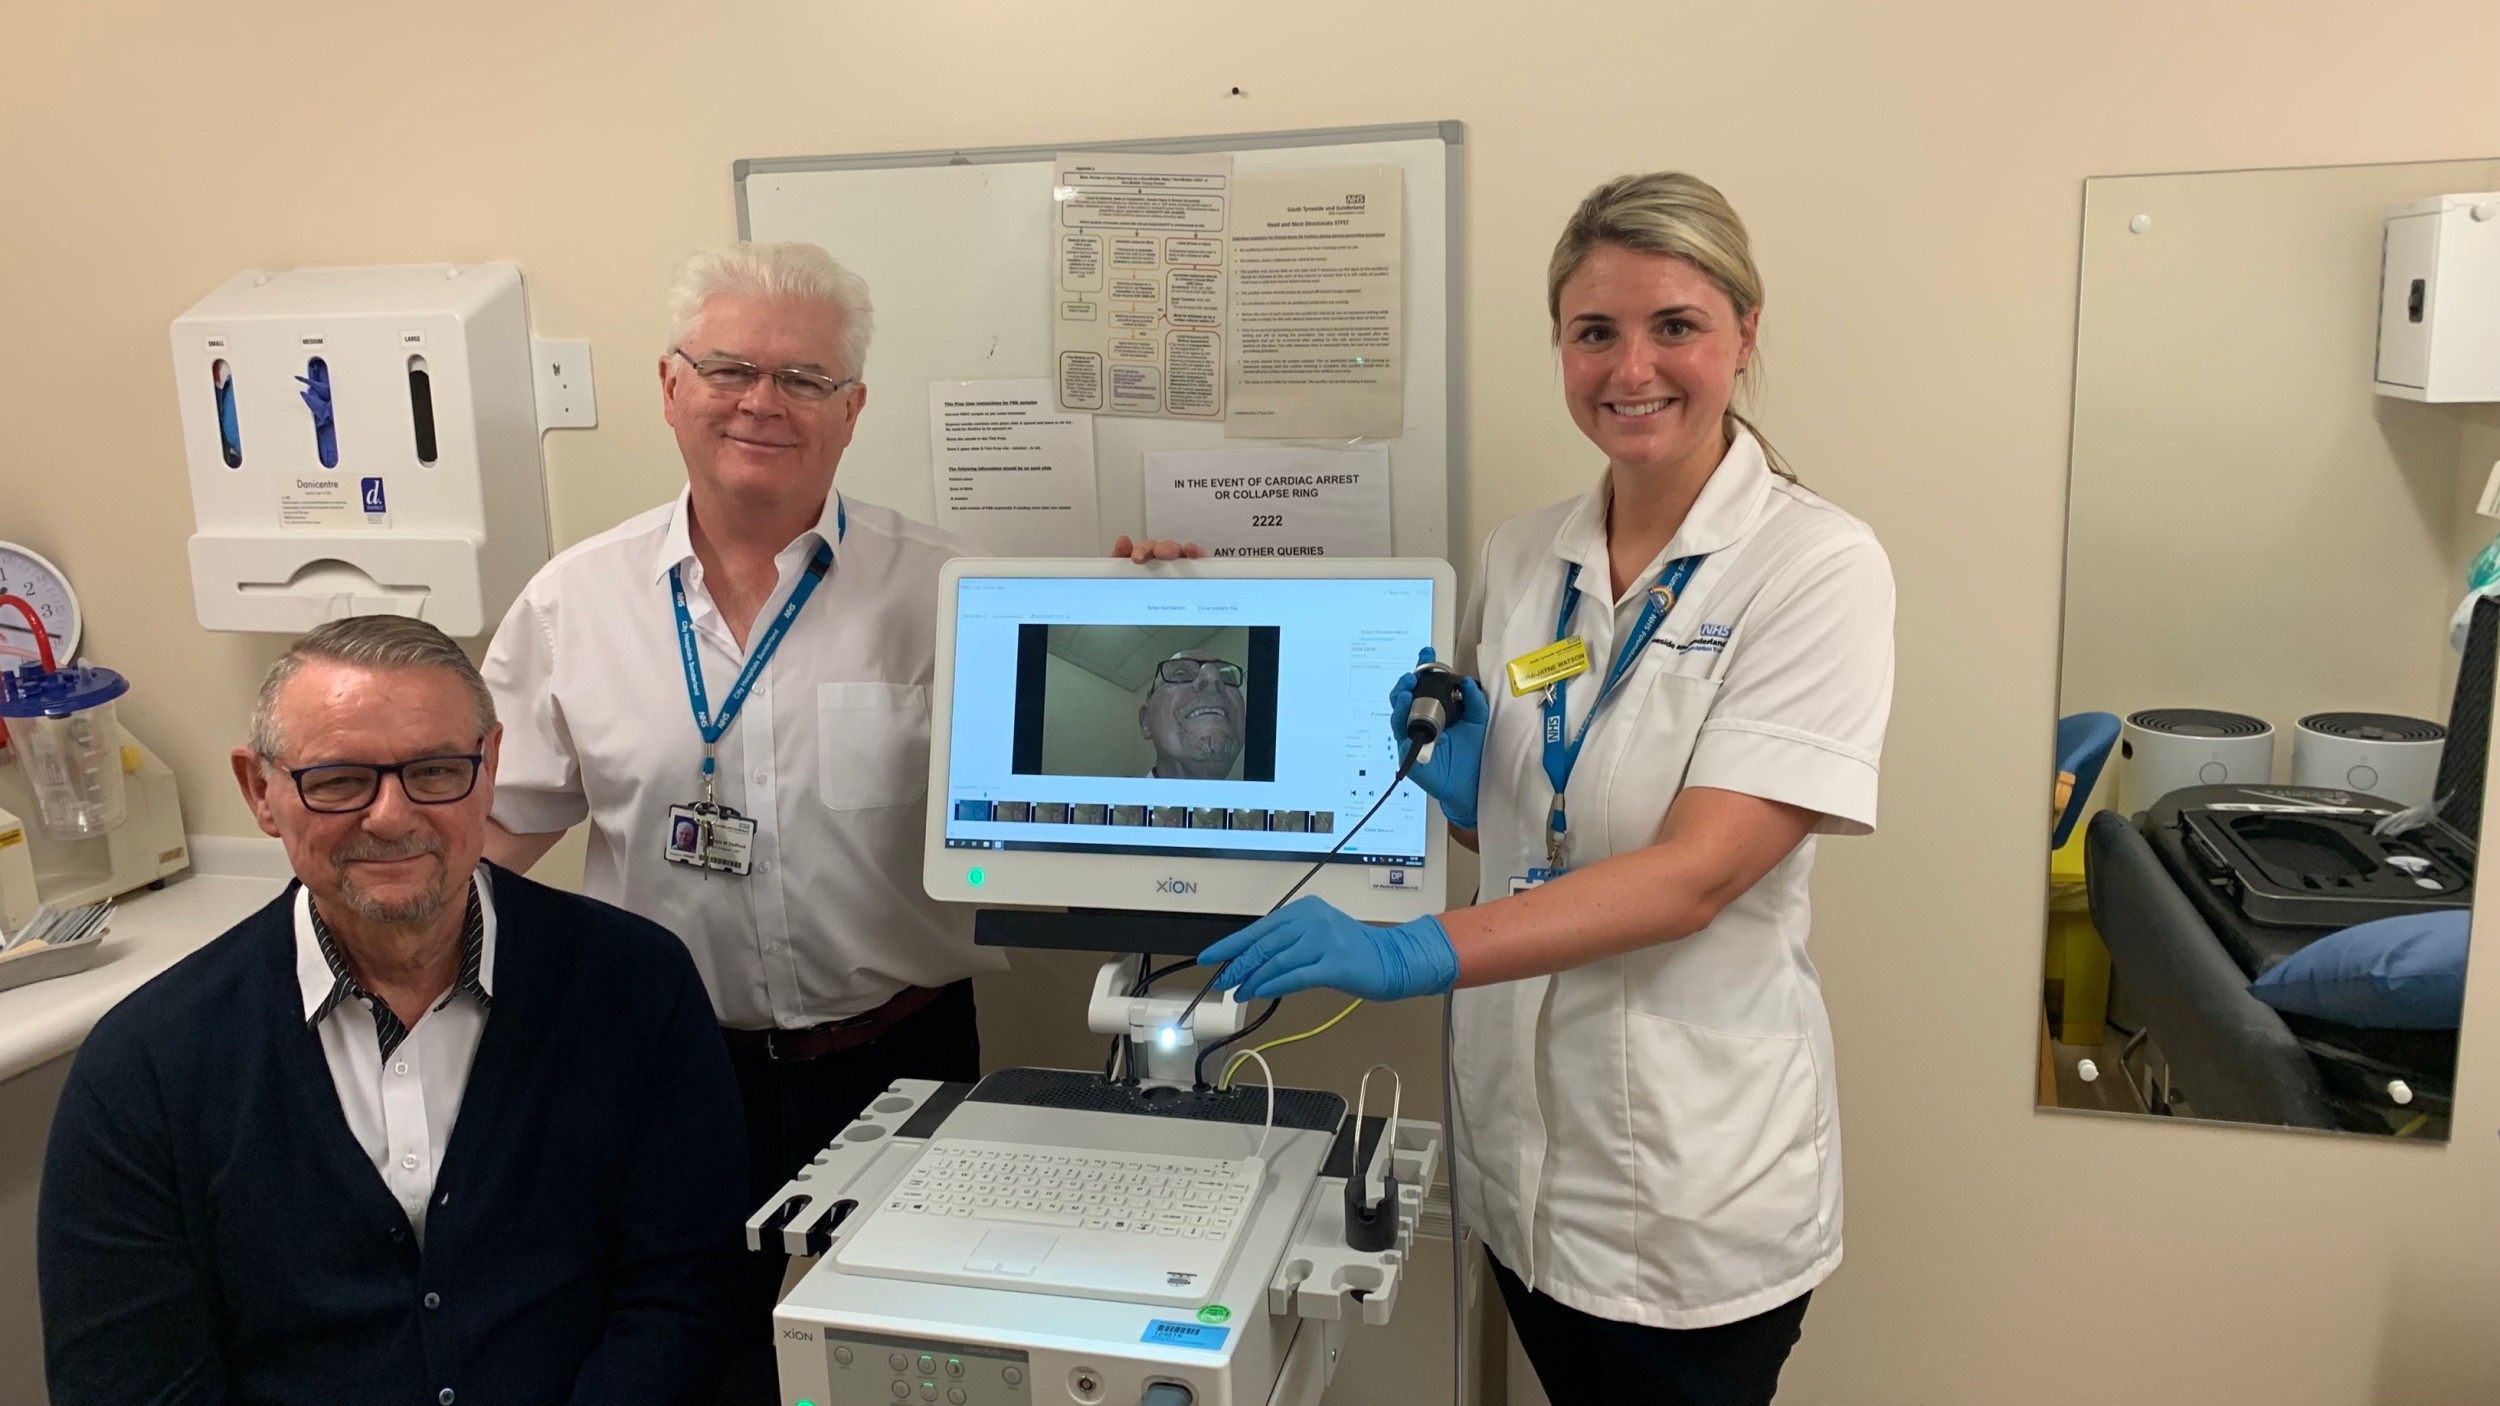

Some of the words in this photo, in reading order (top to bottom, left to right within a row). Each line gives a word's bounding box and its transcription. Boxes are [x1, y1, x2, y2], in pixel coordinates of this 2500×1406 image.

[297, 479, 338, 488] Danicentre
[1175, 480, 1184, 488] IN
[1187, 479, 1208, 488] THE
[1211, 478, 1244, 487] EVENT
[1248, 477, 1262, 486] OF
[1265, 476, 1312, 486] CARDIAC
[1316, 475, 1359, 484] ARREST
[1215, 491, 1230, 500] OR
[1233, 489, 1289, 499] COLLAPSE
[1292, 489, 1318, 498] RING
[1252, 515, 1283, 527] 2222
[1214, 548, 1236, 557] ANY
[1239, 547, 1274, 556] OTHER
[1277, 547, 1324, 556] QUERIES
[24, 582, 35, 596] 2
[41, 604, 53, 618] 3
[784, 604, 796, 619] NHS
[1644, 613, 1657, 630] NHS
[1700, 624, 1732, 637] NHS
[684, 633, 693, 661] Hospitals
[734, 685, 745, 700] City
[741, 660, 760, 688] Hospitals
[757, 629, 779, 661] Sunderland
[1558, 653, 1584, 667] WATSON
[688, 661, 700, 696] Sunderland
[718, 712, 730, 729] NHS
[1548, 717, 1559, 740] NHS
